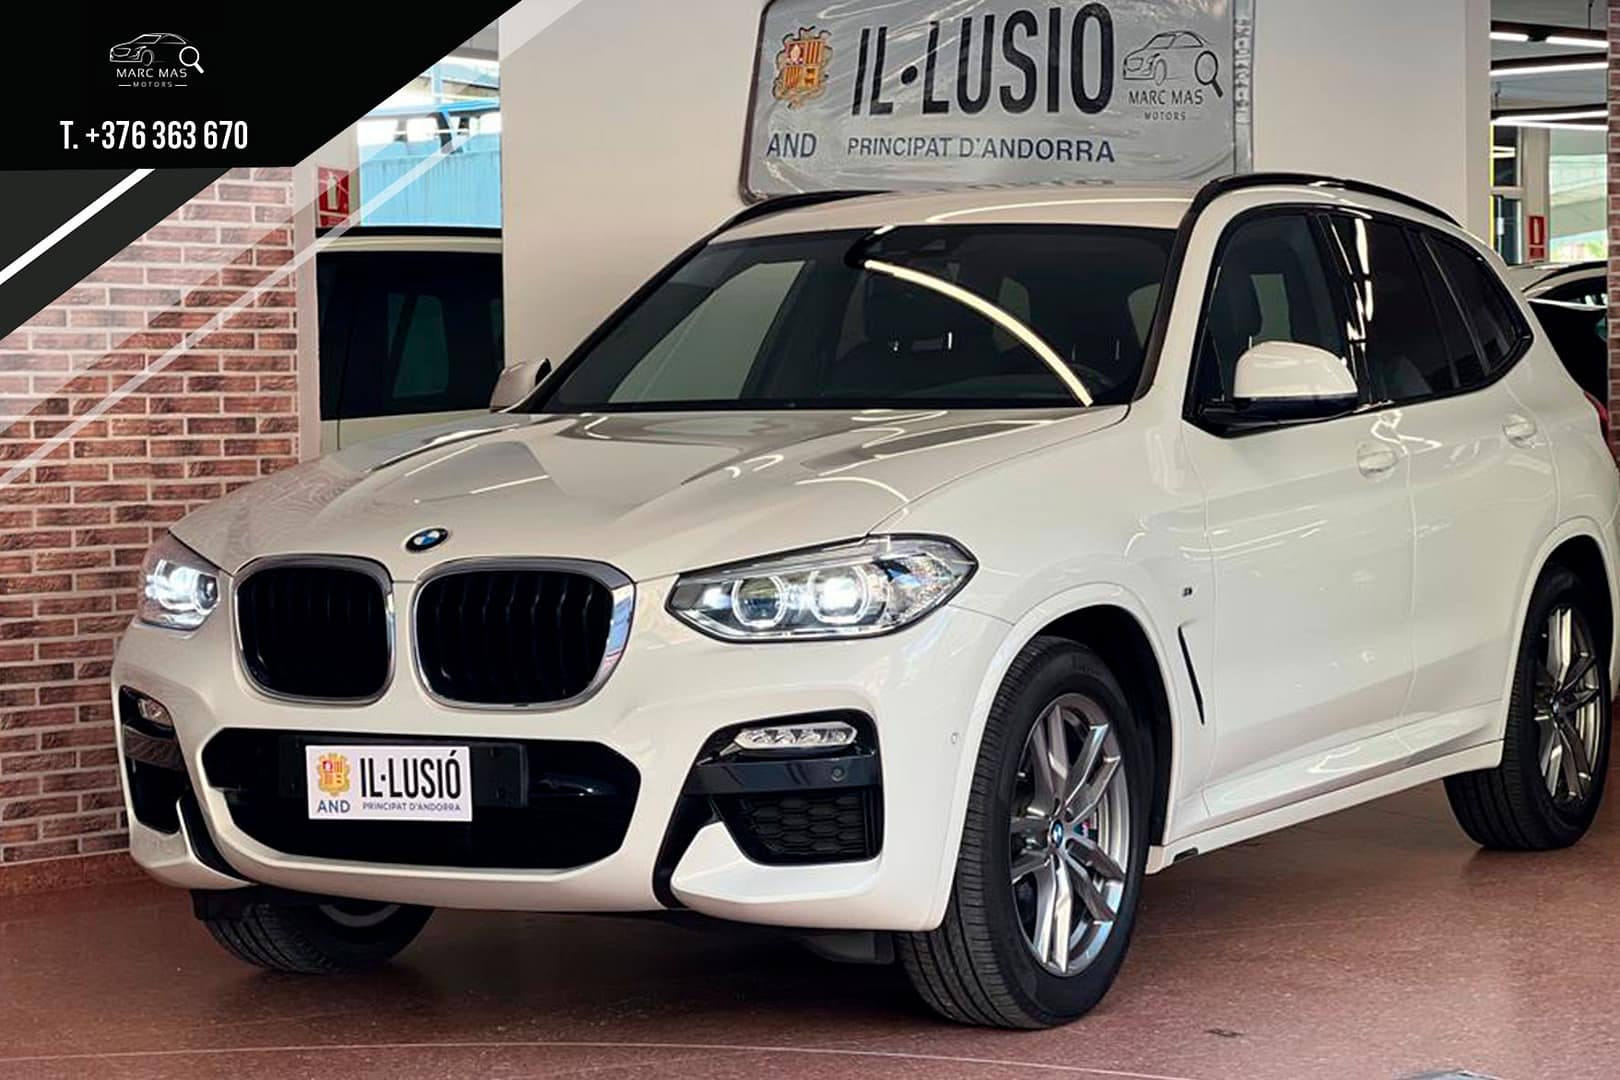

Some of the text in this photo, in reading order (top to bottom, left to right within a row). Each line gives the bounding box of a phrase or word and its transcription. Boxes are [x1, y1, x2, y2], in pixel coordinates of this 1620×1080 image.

[1128, 89, 1204, 105] MARC MAS
[1143, 111, 1187, 121] MOTORS
[766, 132, 818, 158] AND
[847, 137, 1116, 163] PRINCIPAT D'ANDORRA
[317, 800, 351, 813] AND
[362, 802, 407, 811] PRINCIPAT
